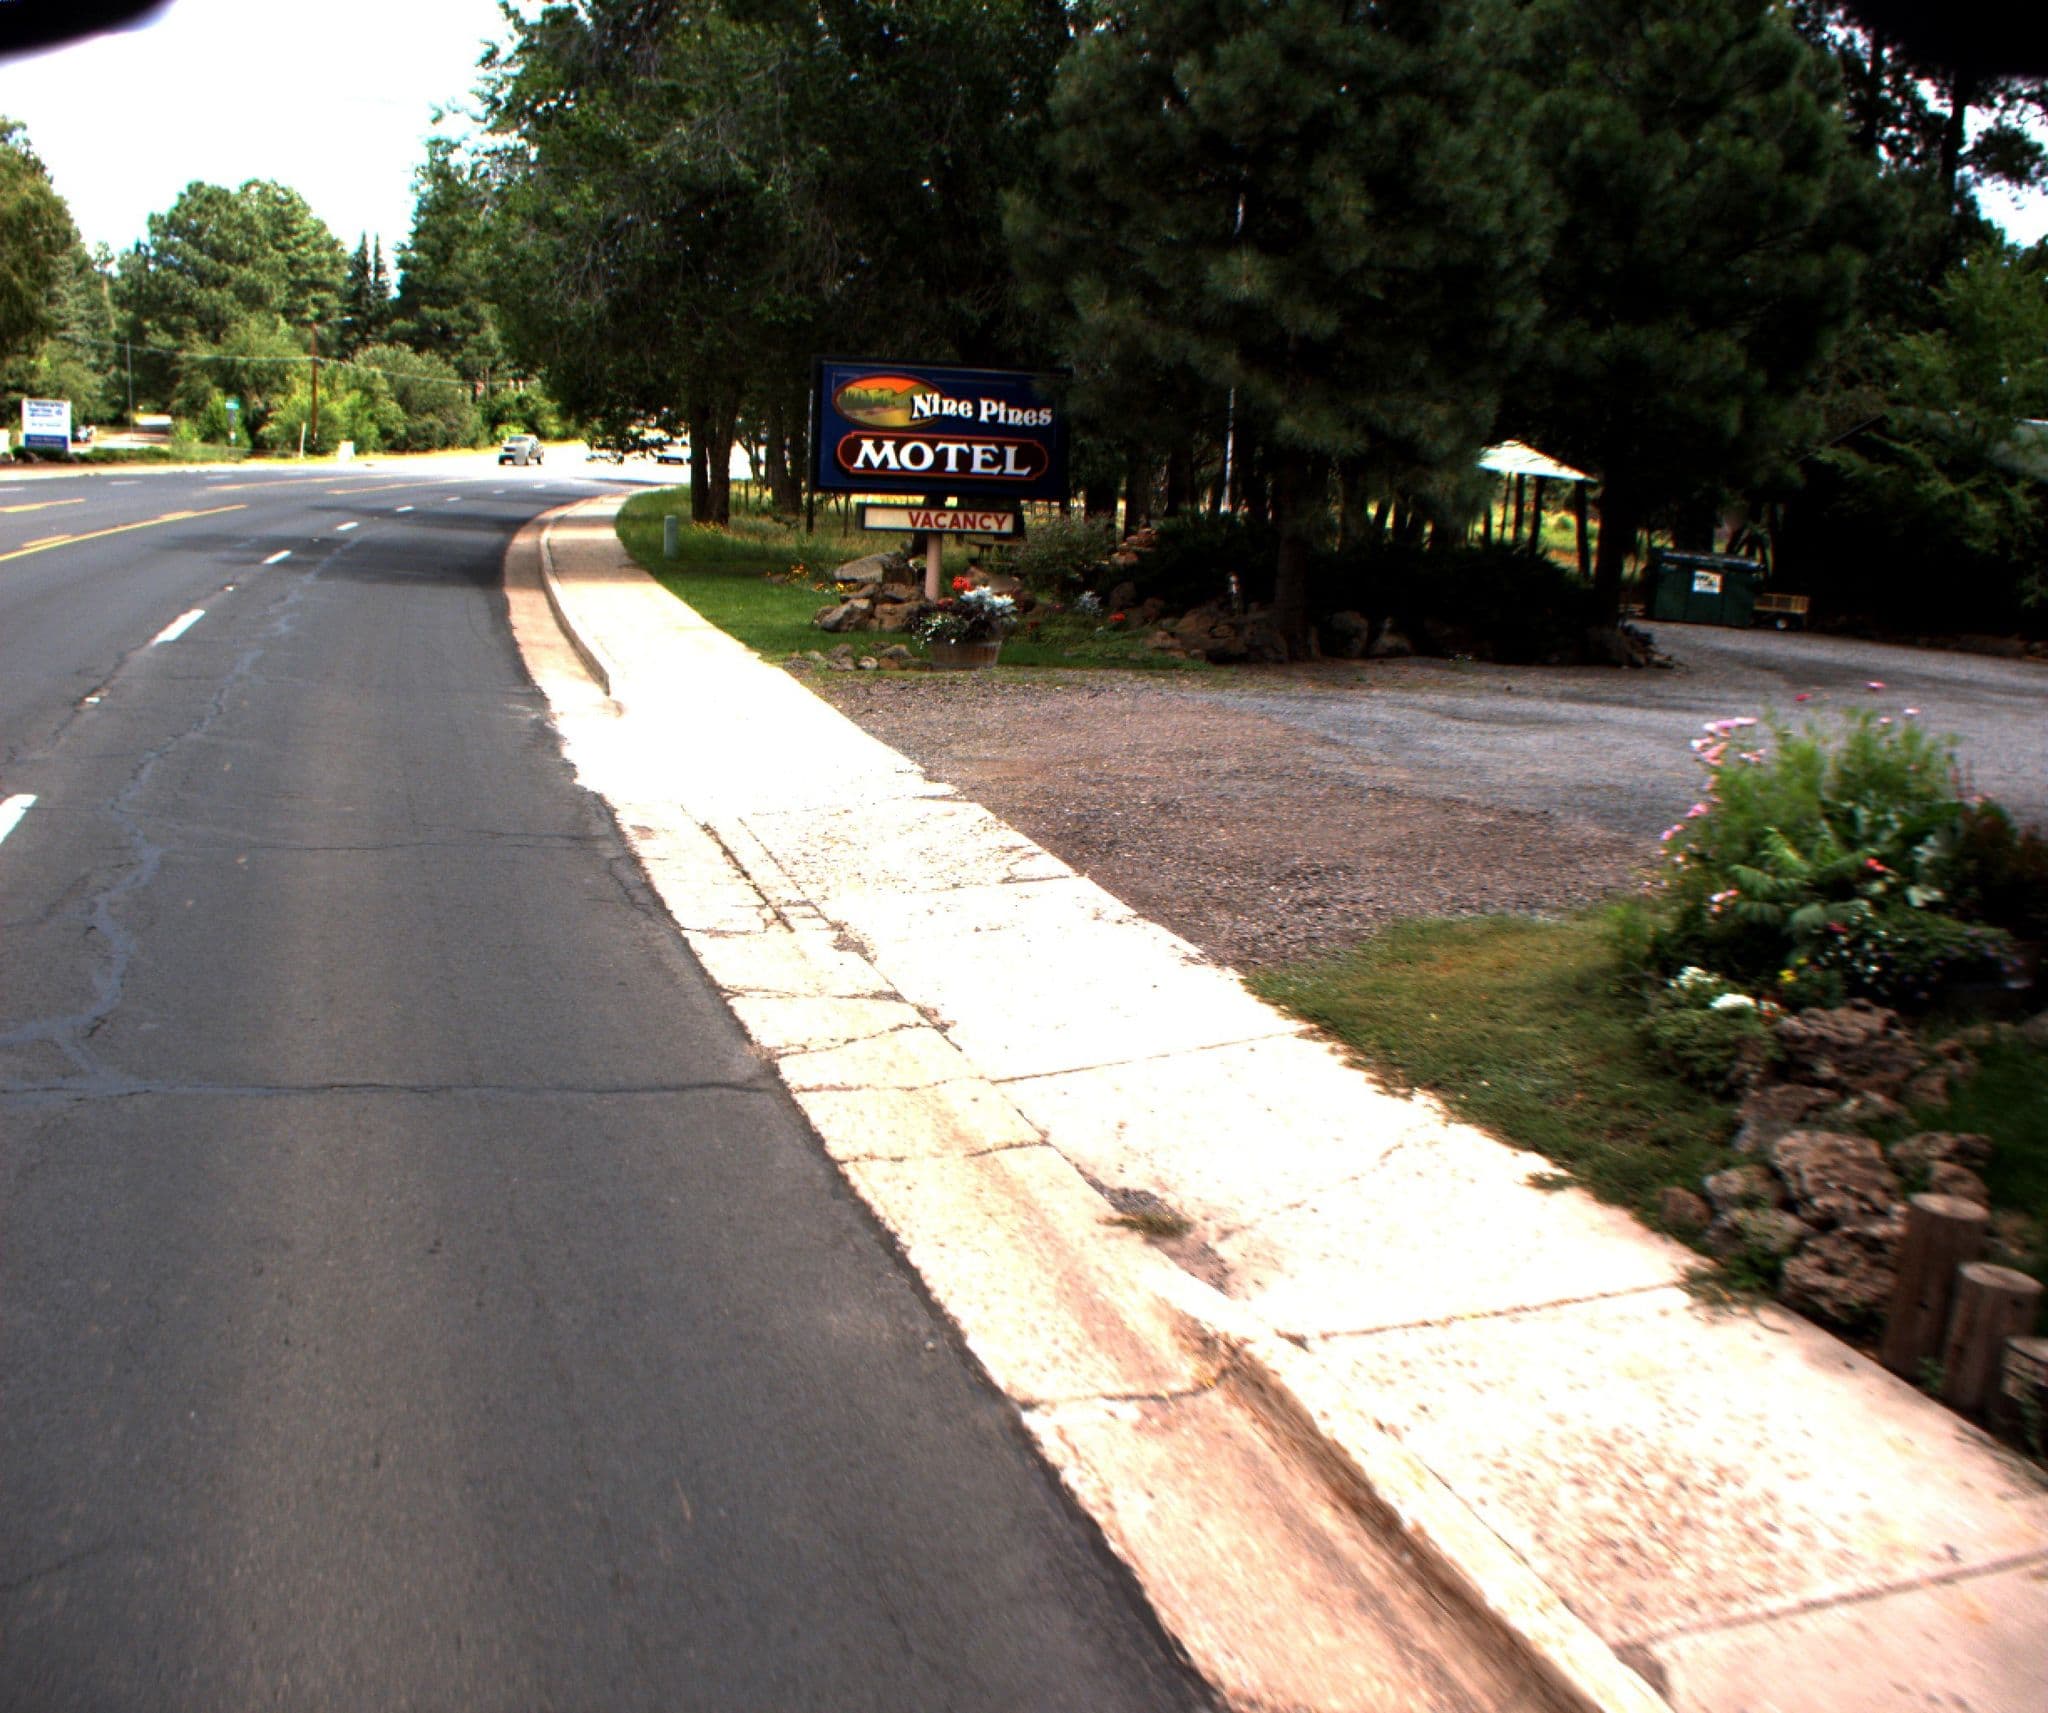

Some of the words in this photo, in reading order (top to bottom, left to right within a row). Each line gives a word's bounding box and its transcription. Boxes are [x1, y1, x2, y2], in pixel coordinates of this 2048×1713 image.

[911, 393, 973, 419] Nine
[979, 398, 1052, 426] Pines
[853, 440, 1031, 476] MOTEL
[908, 511, 1008, 530] VACANCY
